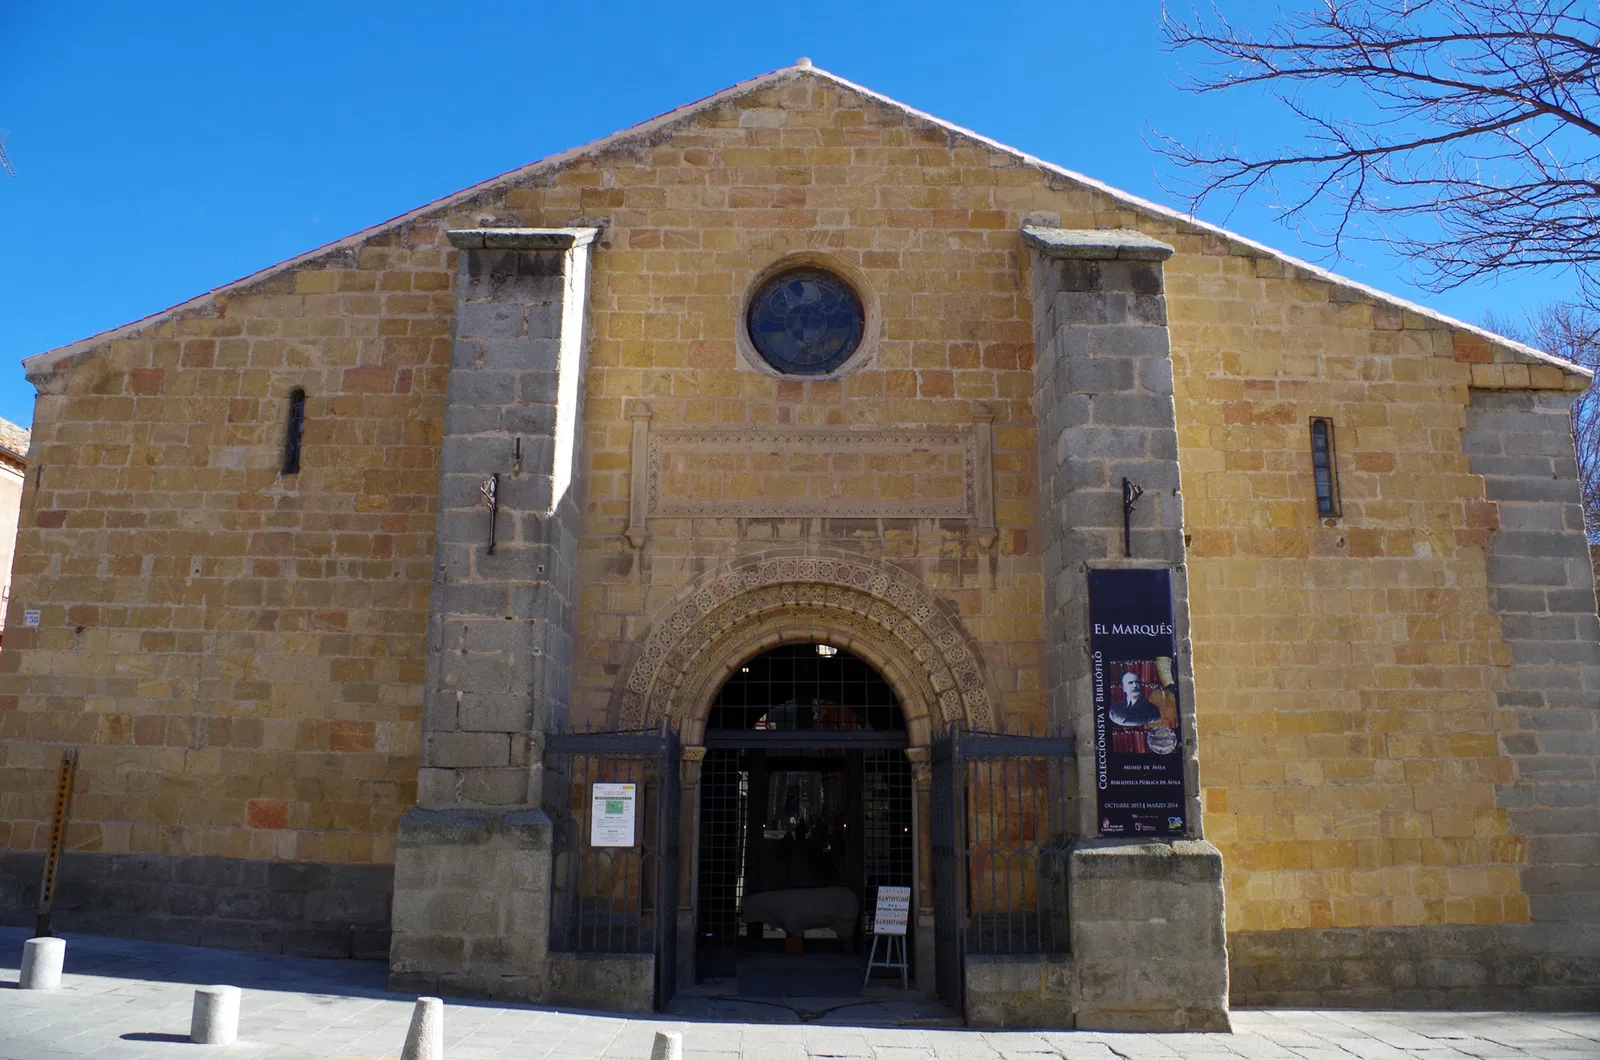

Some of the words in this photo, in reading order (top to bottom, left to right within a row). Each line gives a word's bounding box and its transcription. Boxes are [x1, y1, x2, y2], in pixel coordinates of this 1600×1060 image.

[1094, 623, 1108, 634] EL
[1112, 622, 1172, 636] MARQUÉS
[1094, 650, 1104, 702] BIBLIÓFILO
[1098, 712, 1108, 790] COLECCIONISTA
